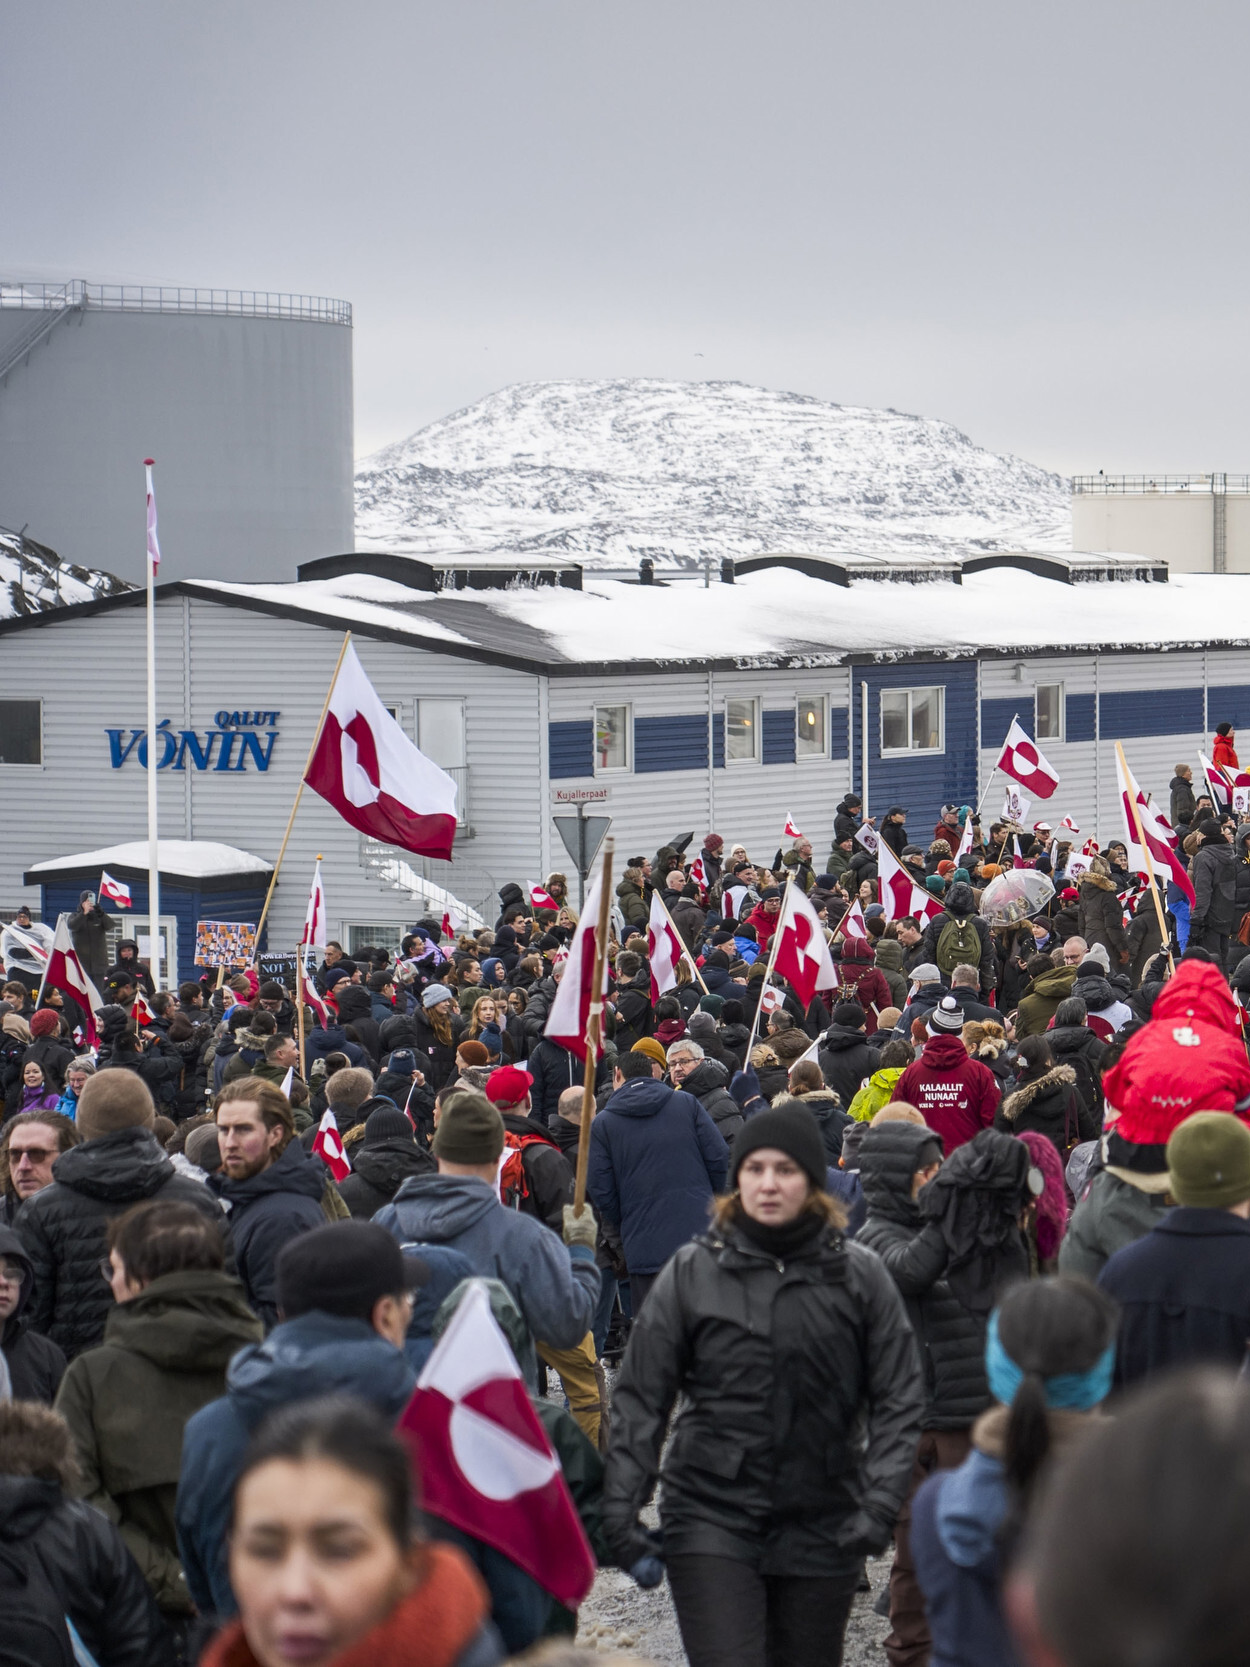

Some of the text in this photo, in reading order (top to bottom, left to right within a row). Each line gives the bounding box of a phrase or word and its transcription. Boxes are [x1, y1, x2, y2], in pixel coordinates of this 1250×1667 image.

[214, 710, 281, 730] QALUT
[104, 719, 280, 771] VÓNIN
[556, 789, 608, 804] Kujallerpaat
[261, 963, 285, 974] NOT
[919, 1083, 964, 1092] KALAALLIT
[924, 1092, 959, 1101] NUNAAT
